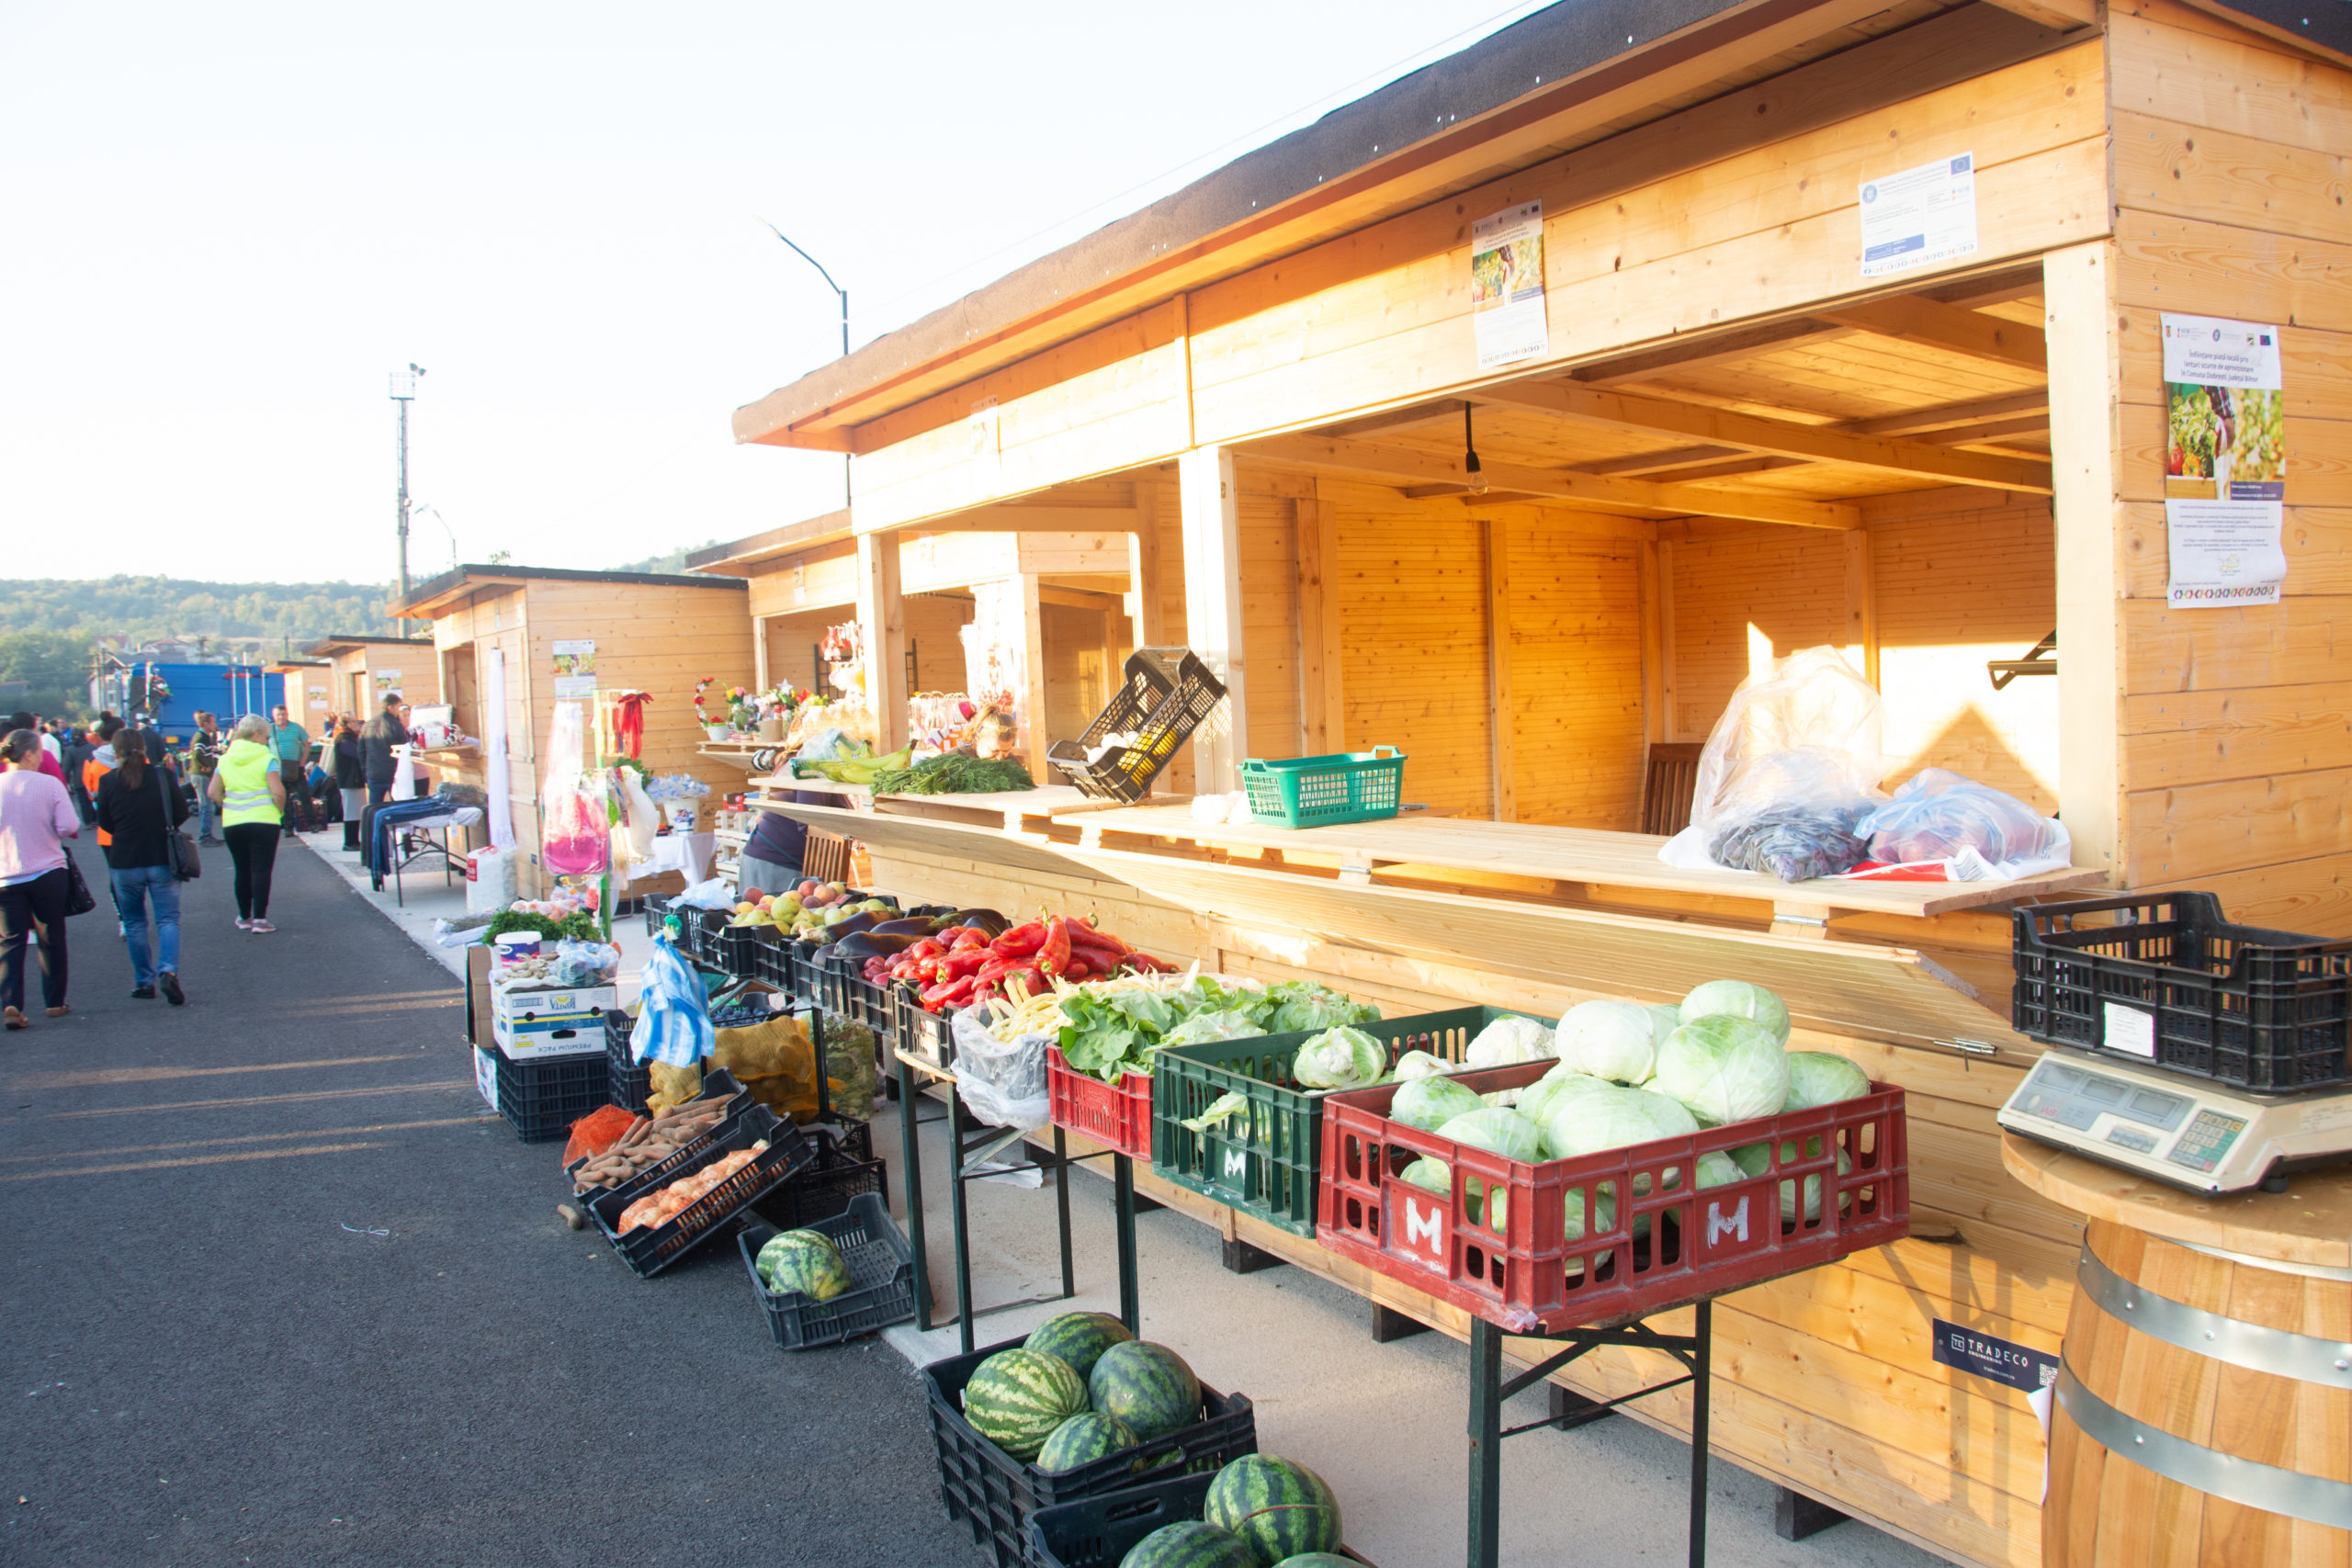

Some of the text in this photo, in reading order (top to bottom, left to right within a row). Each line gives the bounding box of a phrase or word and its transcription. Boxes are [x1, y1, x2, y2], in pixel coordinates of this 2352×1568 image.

[559, 1043, 592, 1051] PREMIUM
[1224, 1147, 1246, 1185] M
[1406, 1197, 1442, 1256] M
[1708, 1195, 1749, 1249] M
[1968, 1338, 2029, 1367] TRADECO
[1968, 1349, 2003, 1365] ENGINEERING
